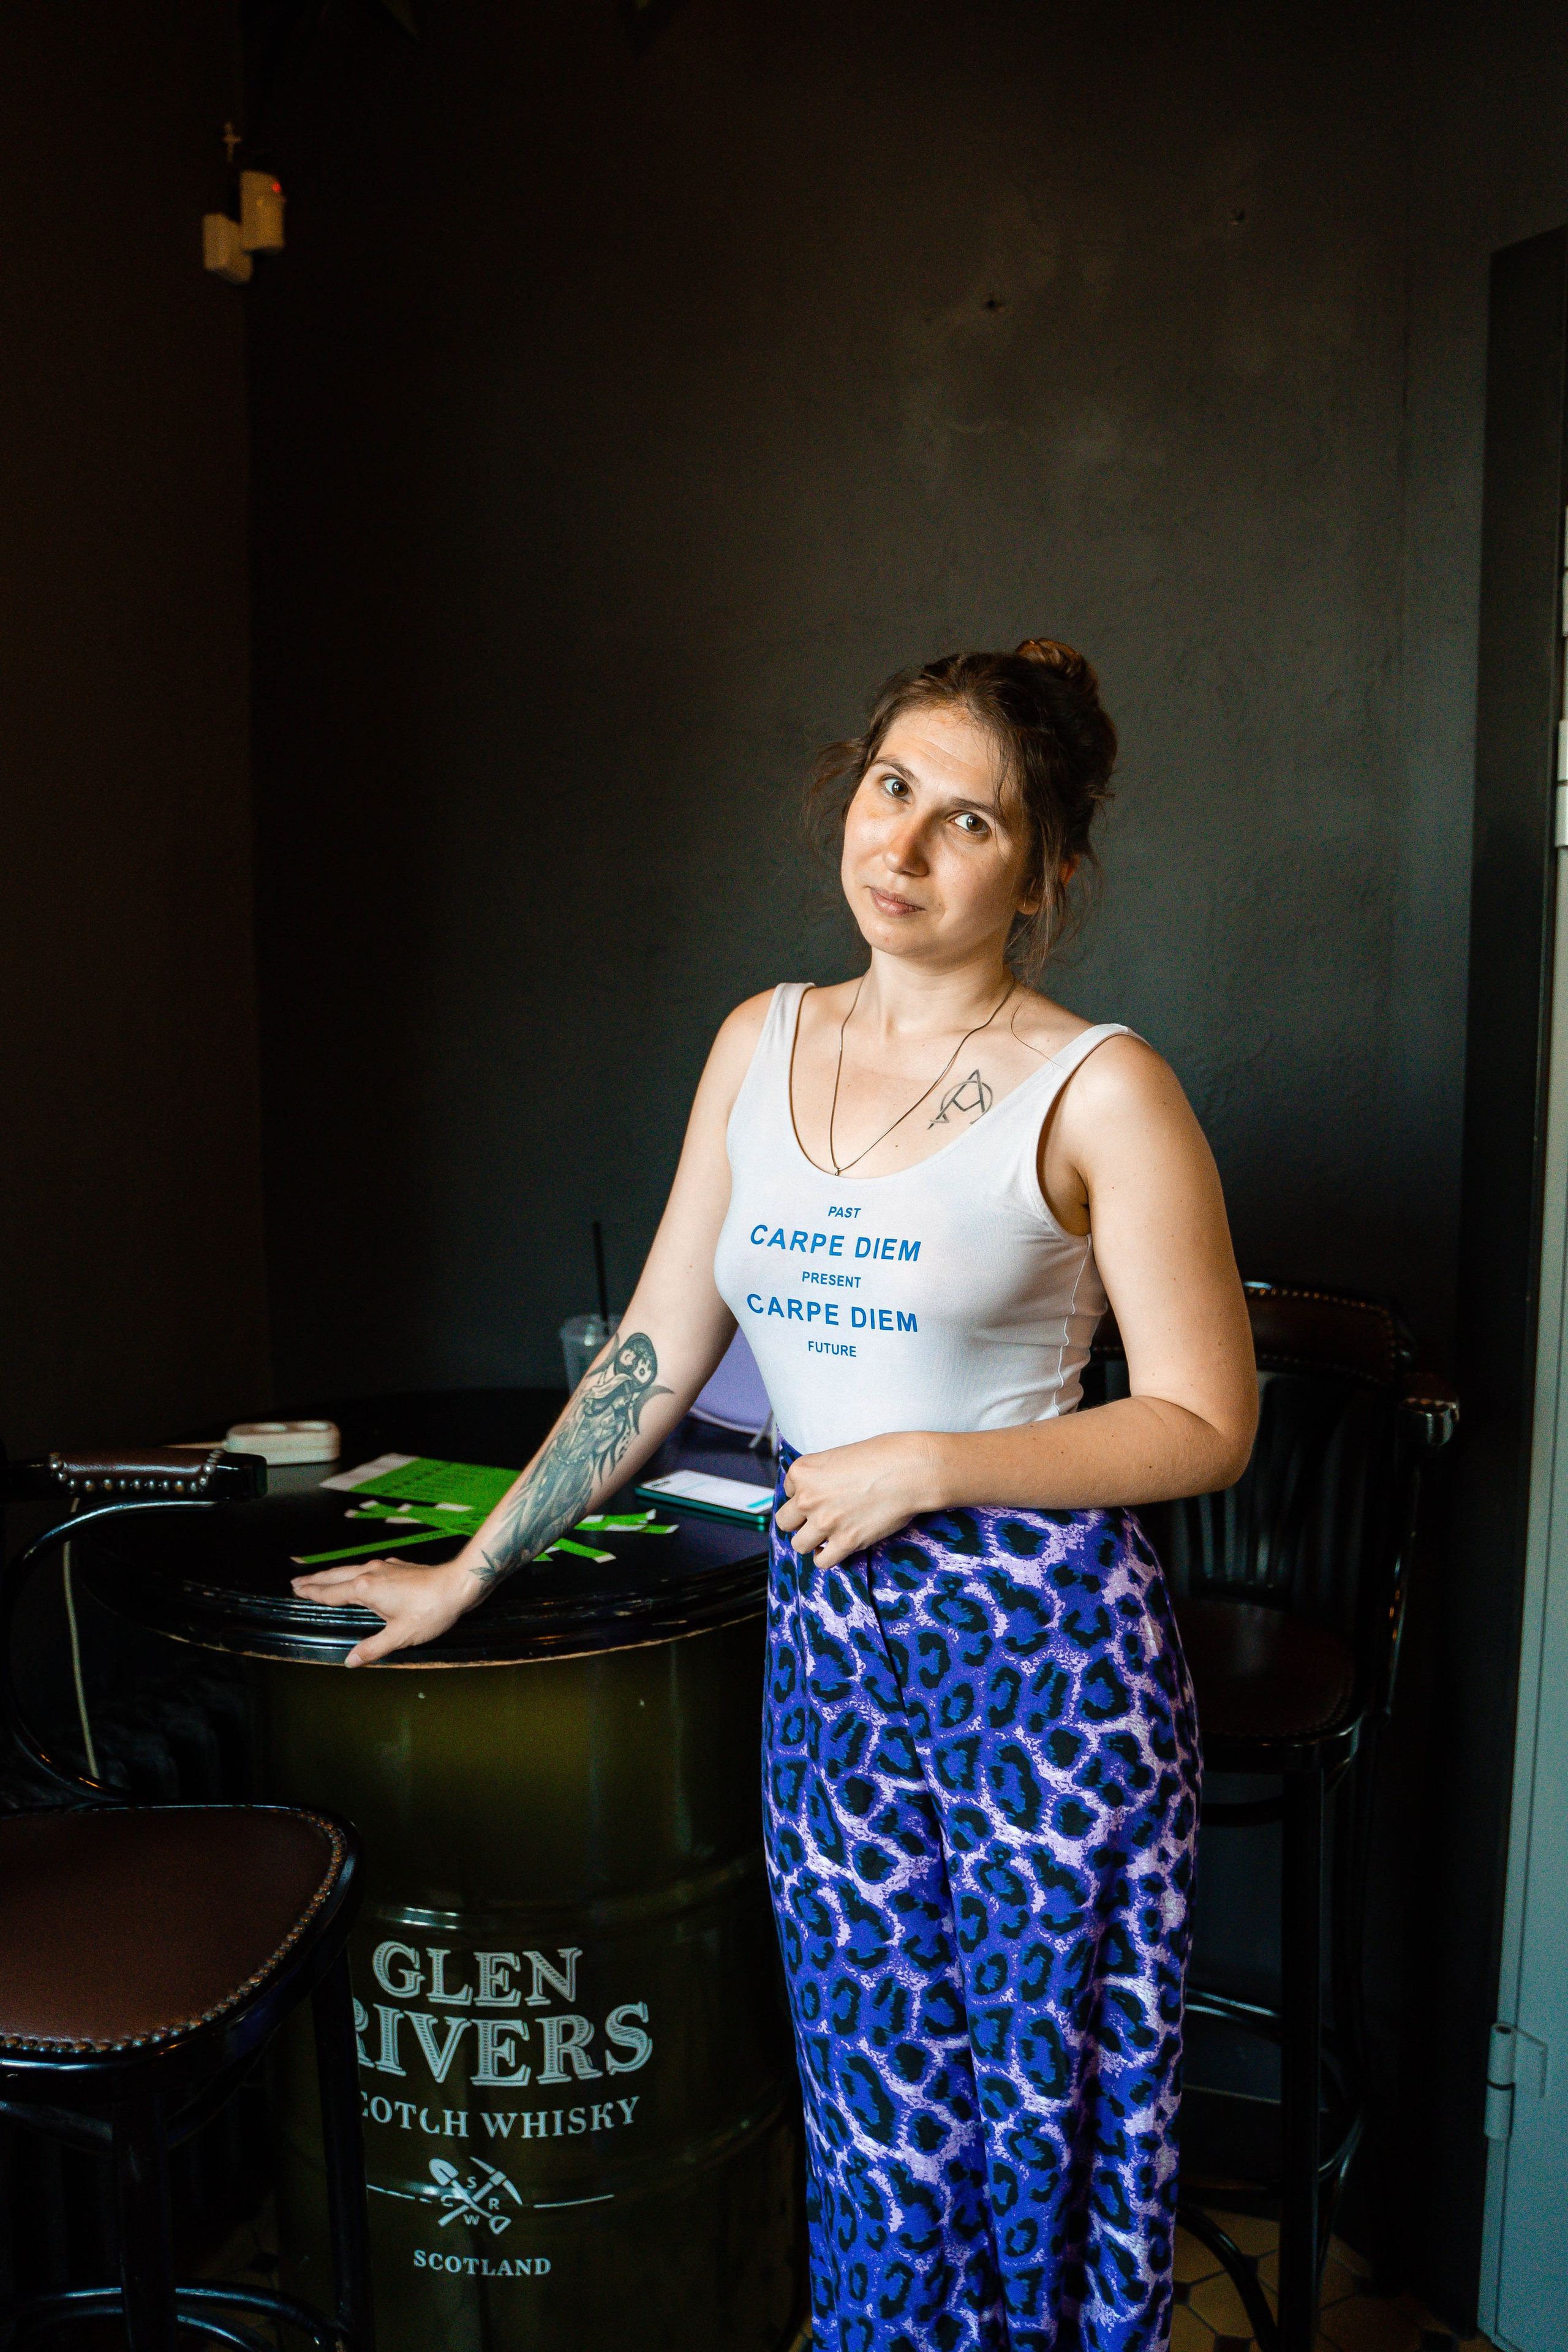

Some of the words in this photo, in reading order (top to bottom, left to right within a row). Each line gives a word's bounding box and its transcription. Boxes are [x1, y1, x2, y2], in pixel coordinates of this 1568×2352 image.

[827, 1206, 861, 1218] PAST
[750, 1224, 845, 1256] CARPE
[854, 1236, 921, 1262] DIEM
[802, 1271, 861, 1288] PRESENT
[747, 1294, 839, 1325] CARPE
[851, 1306, 918, 1332] DIEM
[808, 1341, 857, 1357] FUTURE
[371, 1940, 583, 2007] GLEN
[360, 2090, 470, 2138] OTCH
[480, 2095, 641, 2139] WHISKY
[413, 2248, 552, 2277] SCOTLAND
